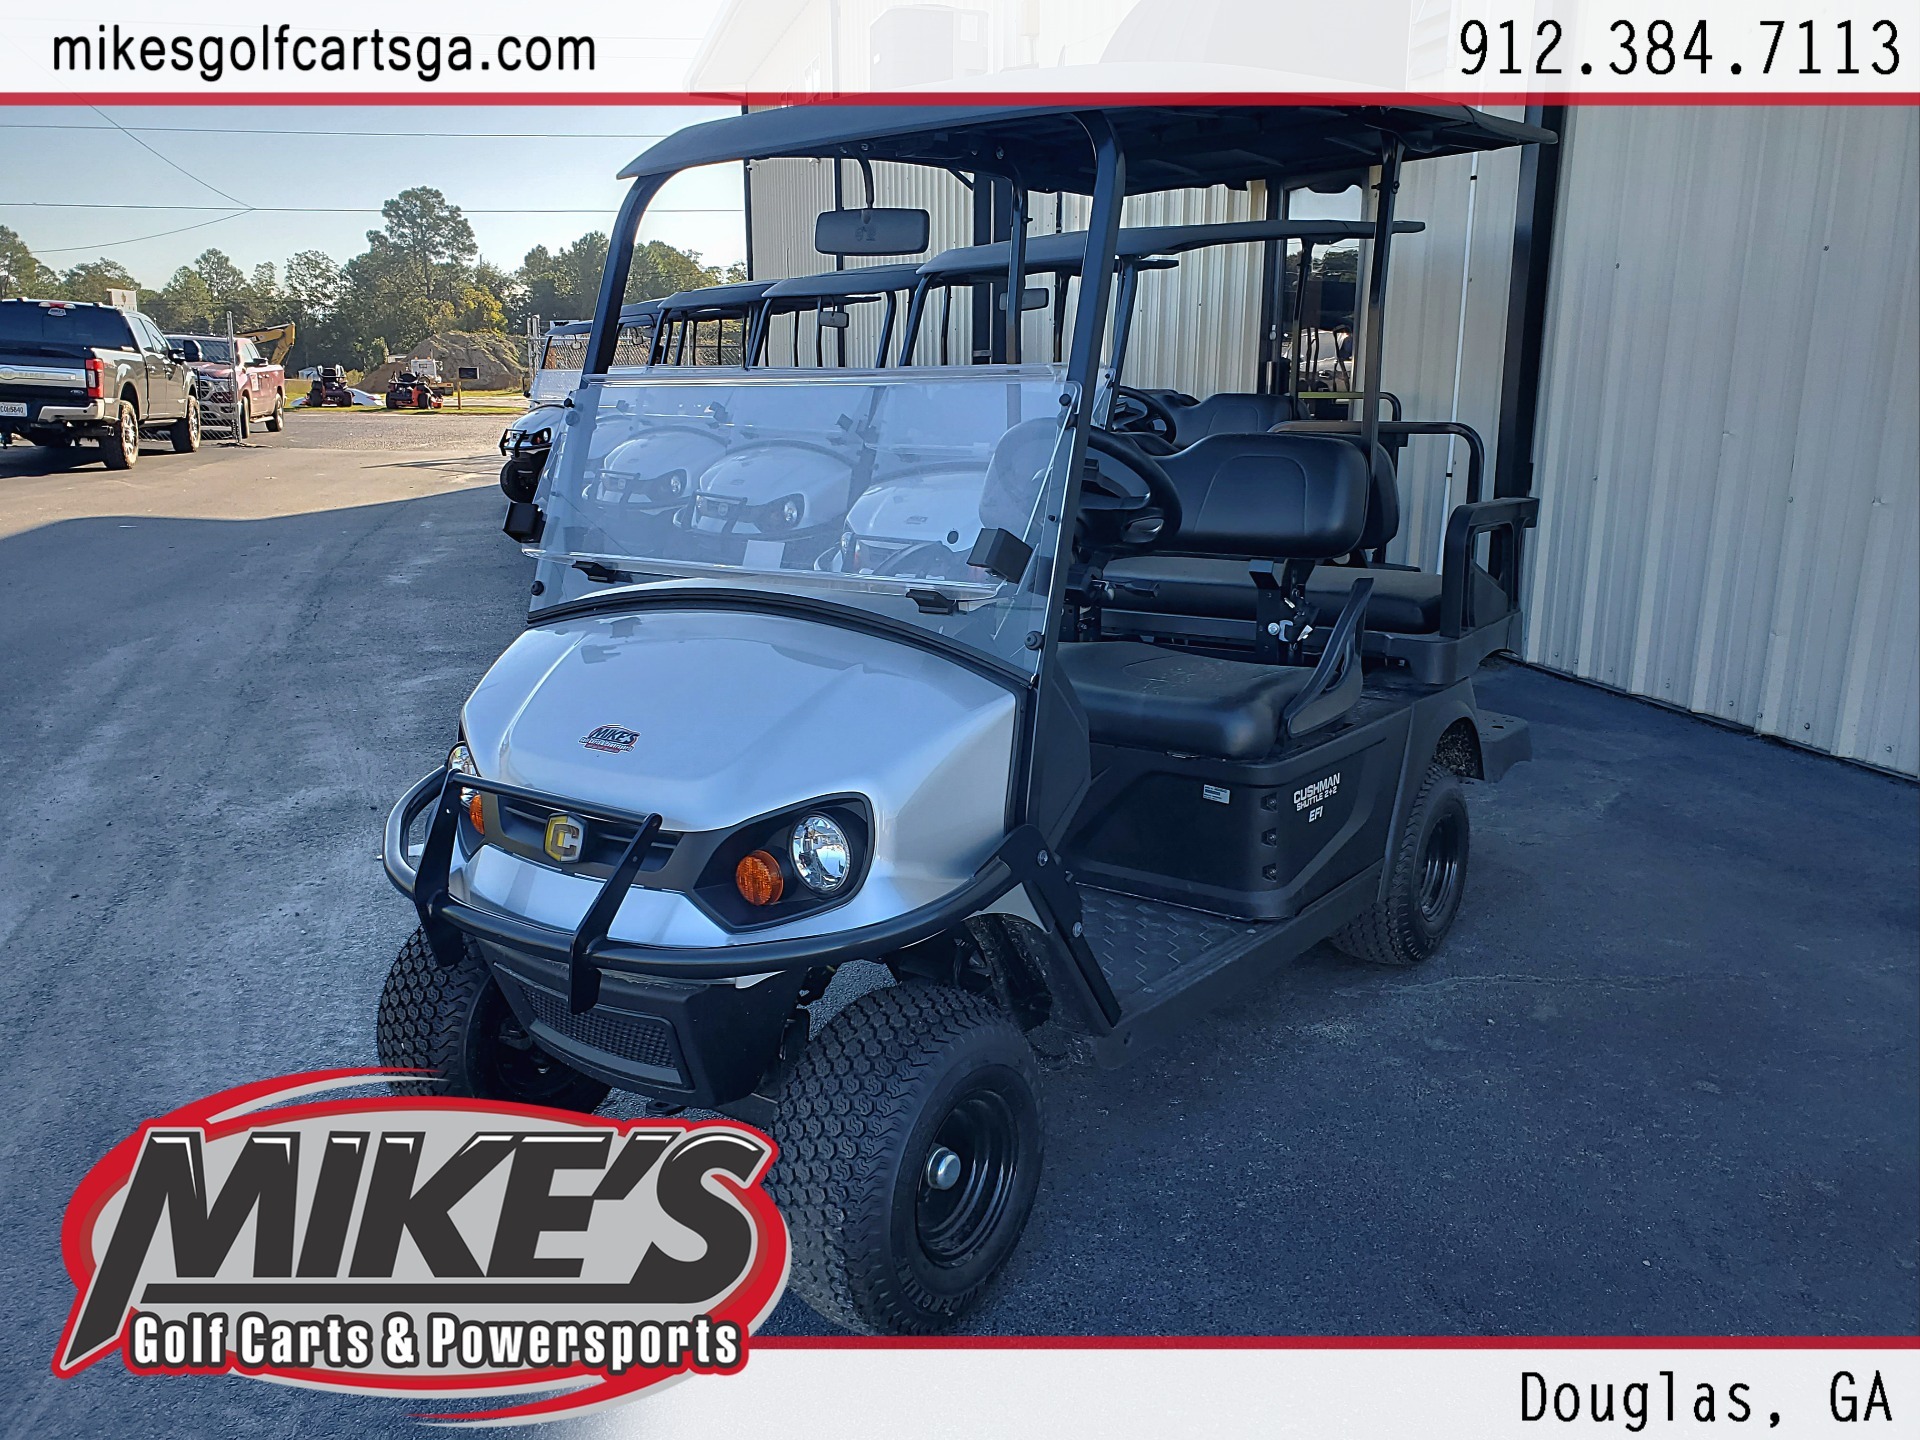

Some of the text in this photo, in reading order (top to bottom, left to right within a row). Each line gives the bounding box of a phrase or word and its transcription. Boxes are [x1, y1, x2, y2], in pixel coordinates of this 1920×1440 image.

[1293, 772, 1340, 804] CUSHMAN
[1296, 785, 1337, 811] SHUTTLE 2+2
[1308, 805, 1323, 822] EFI
